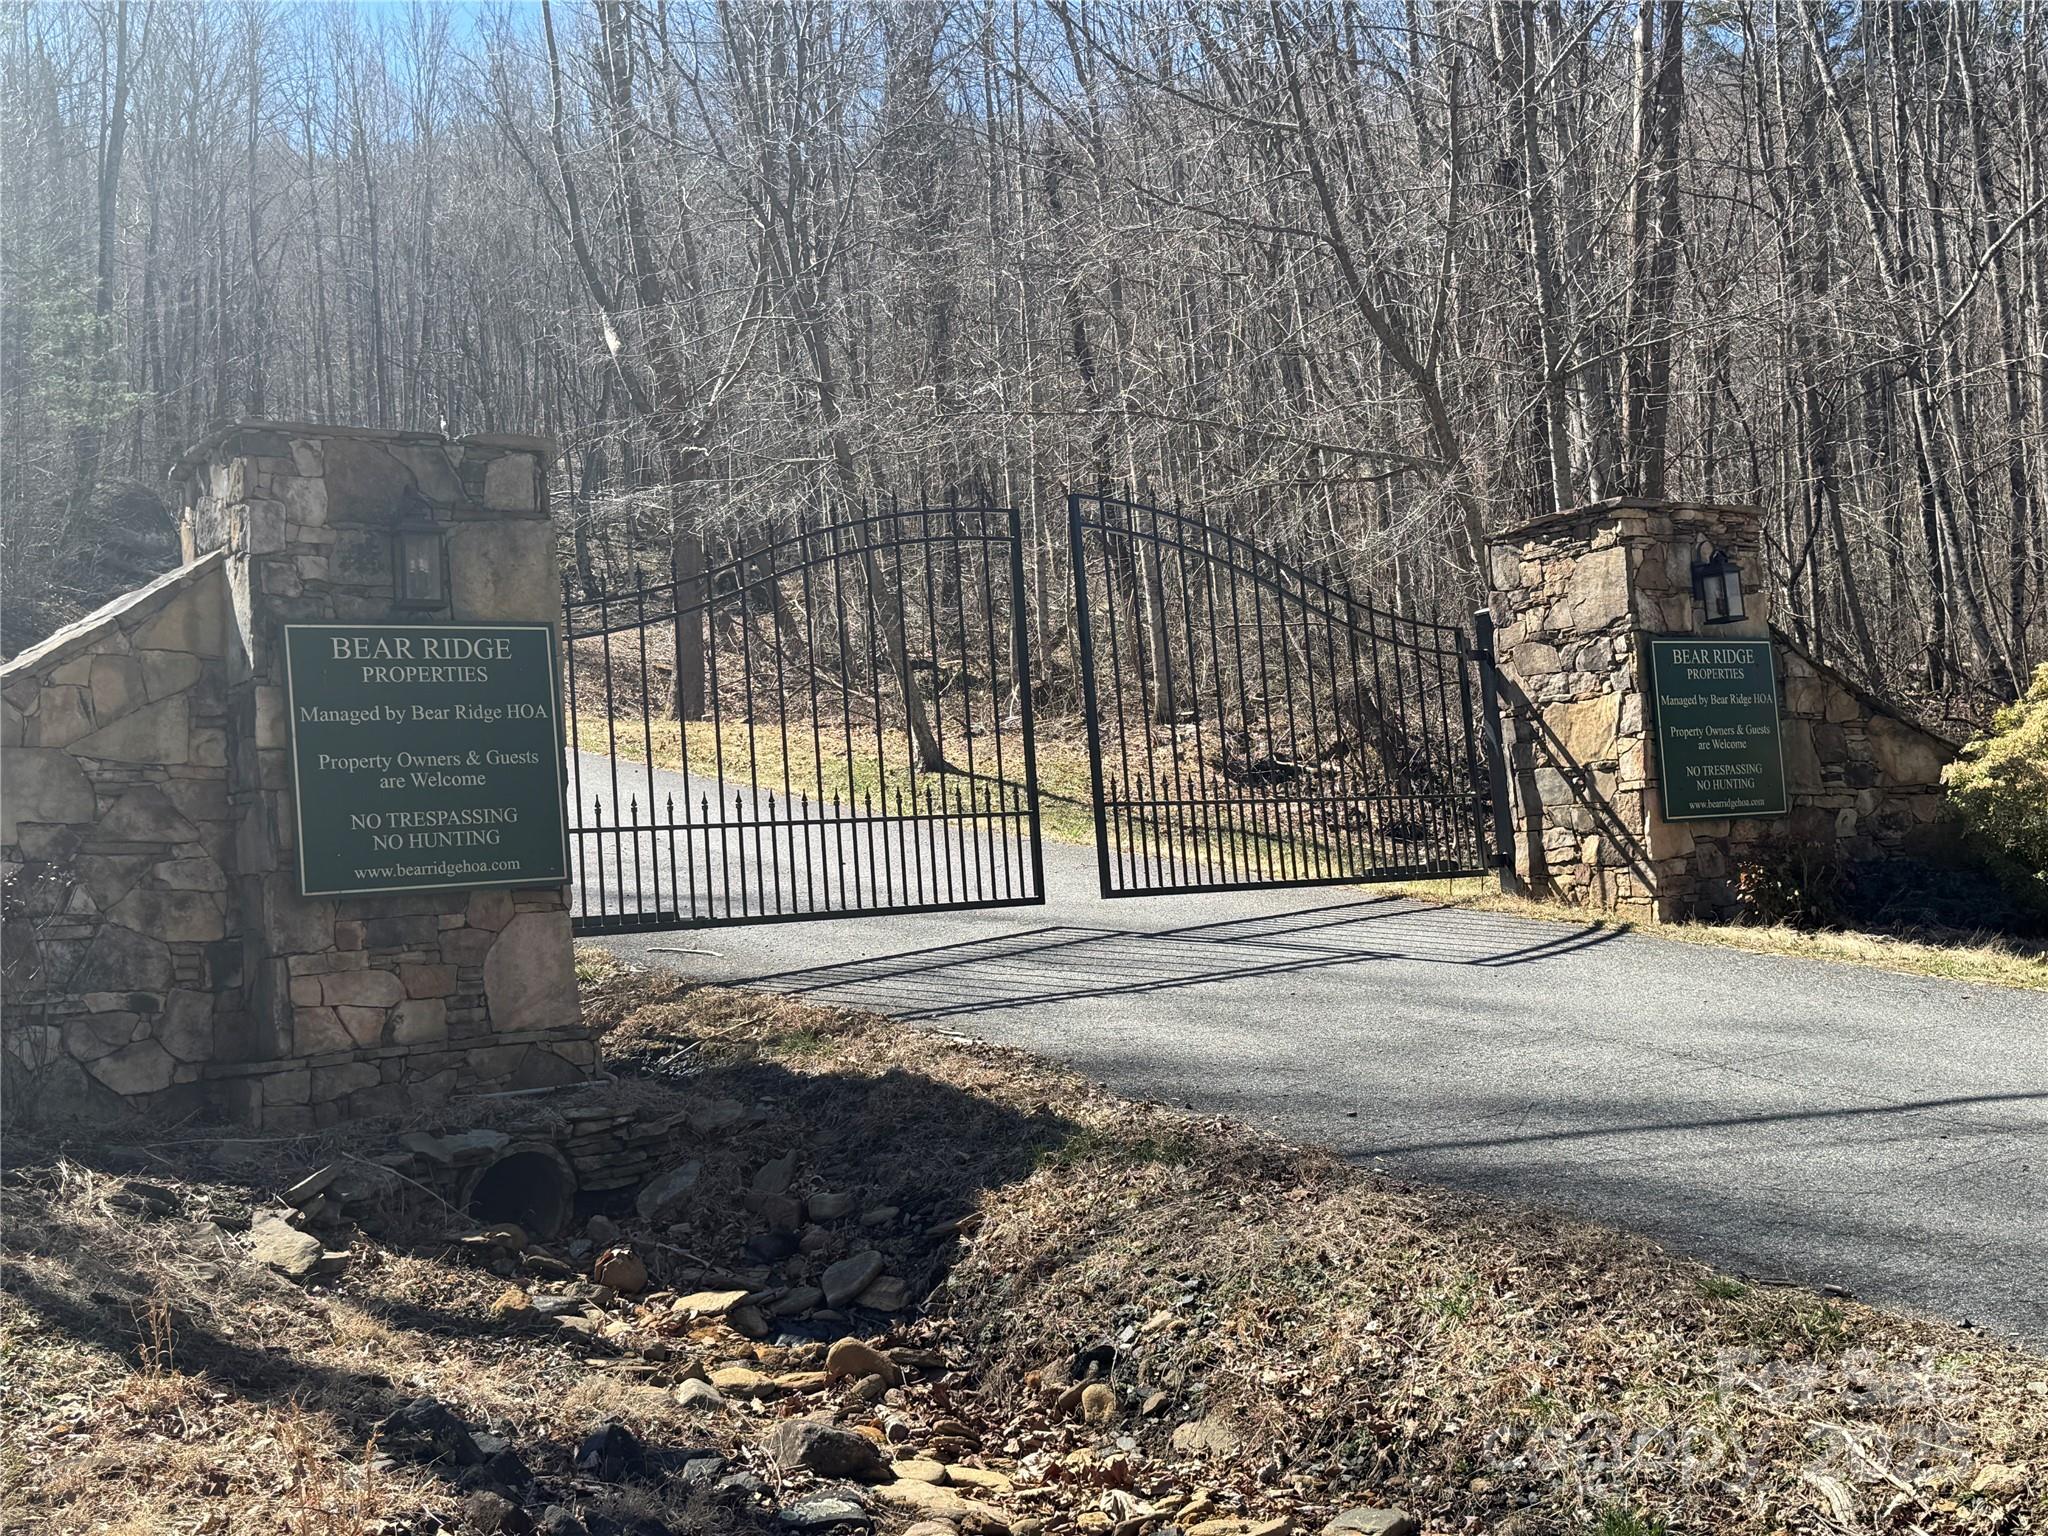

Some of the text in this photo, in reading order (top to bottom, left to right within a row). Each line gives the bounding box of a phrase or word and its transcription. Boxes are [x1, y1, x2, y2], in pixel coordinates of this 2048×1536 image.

[331, 637, 512, 660] BEAR RIDGE
[1673, 650, 1754, 664] BEAR RIDGE
[362, 666, 488, 684] PROPERTIES
[1687, 668, 1744, 680] PROPERTIES
[1661, 694, 1773, 708] Managed by Bear Ridge HOA
[300, 704, 548, 726] Managed by Bear Ridge HOA
[1670, 724, 1770, 739] Property Owners & Guests
[1698, 739, 1747, 750] are Welcome
[318, 750, 539, 773] Property Owners & Guests
[1686, 763, 1762, 777] NO TRESPASSING
[380, 772, 486, 788] are Welcome
[1697, 778, 1755, 791] NO HUNTING
[1689, 798, 1765, 809] www.bearridgehoa.com
[351, 808, 518, 830] NO TRESPASSING
[373, 830, 500, 850] NO HUNTING
[354, 858, 520, 880] www.bearridgehoa.com
